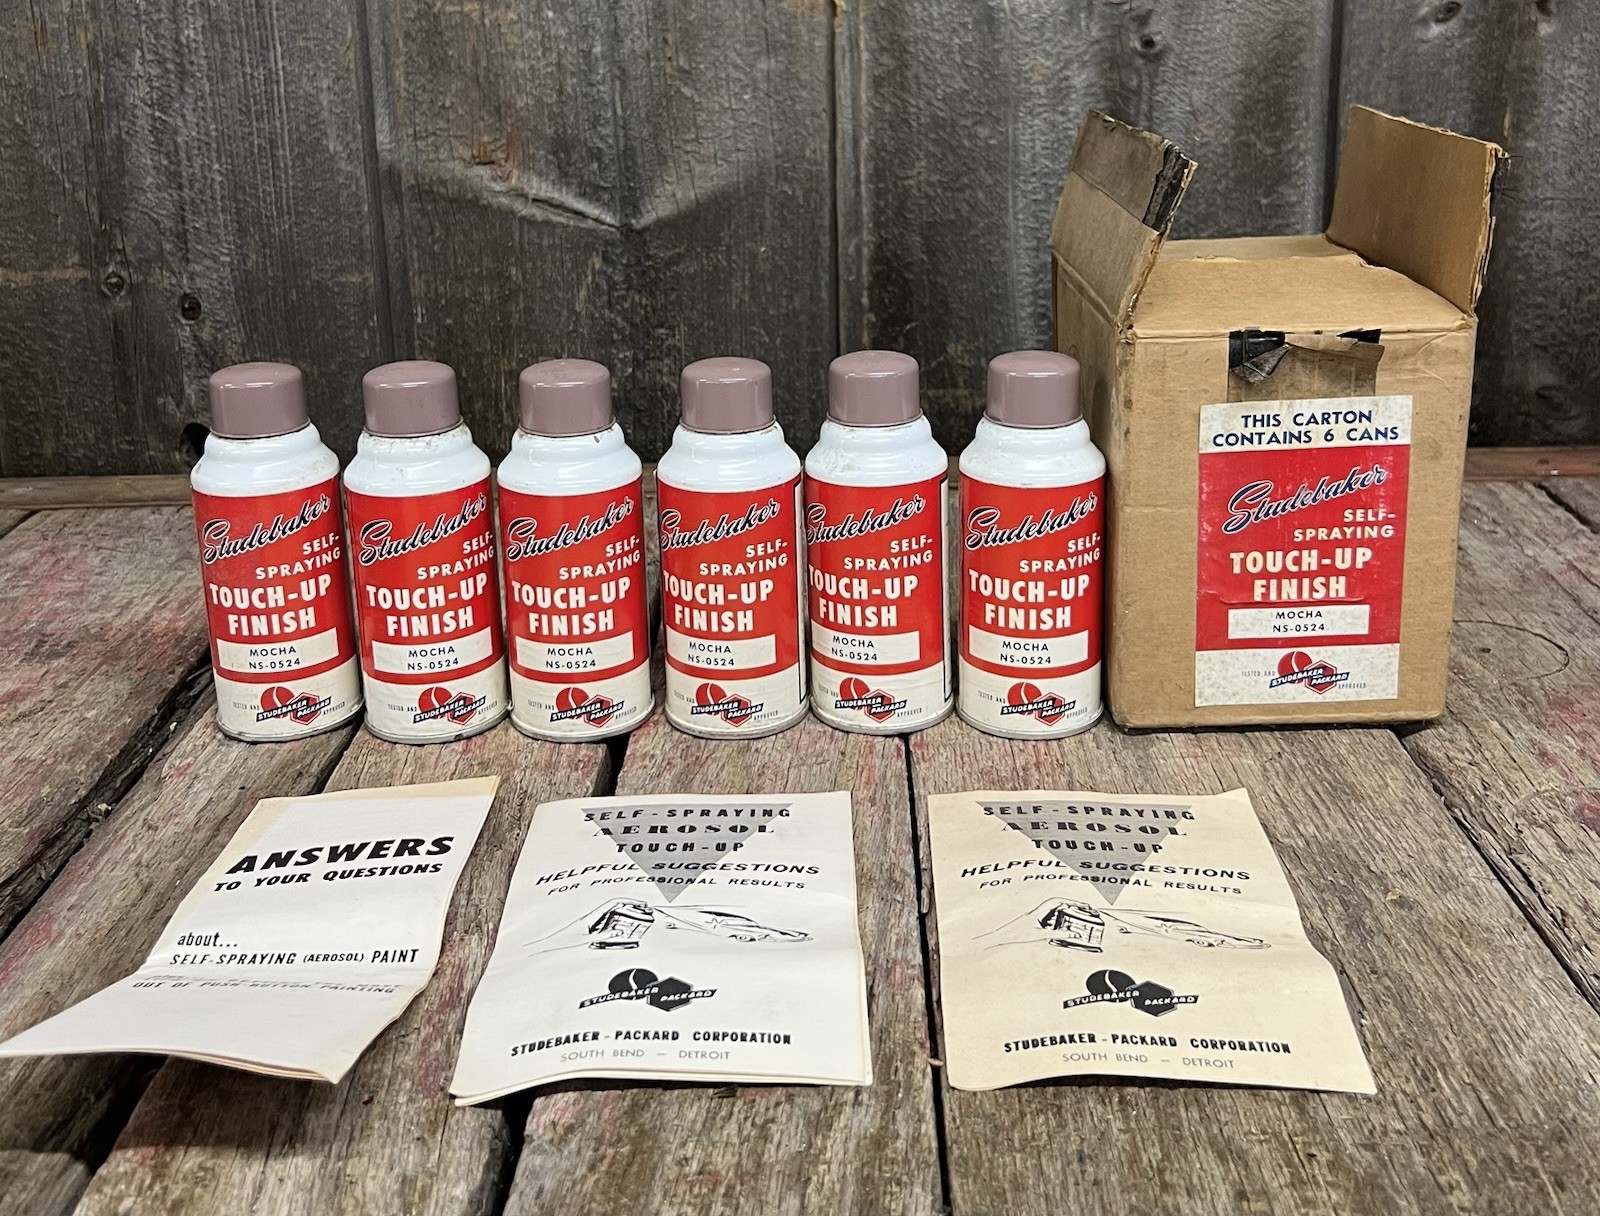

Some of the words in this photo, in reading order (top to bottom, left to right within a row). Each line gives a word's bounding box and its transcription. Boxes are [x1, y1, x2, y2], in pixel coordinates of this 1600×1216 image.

[1241, 414, 1281, 428] THIS
[1293, 410, 1372, 426] CARTON
[1213, 430, 1312, 447] CONTAINS
[1324, 429, 1334, 442] 6
[1346, 427, 1399, 441] CANS
[1222, 464, 1388, 534] Studebaker
[660, 499, 780, 551] Studebaker
[807, 495, 926, 545] Studebaker
[965, 493, 1097, 550] Studebaker
[1343, 509, 1396, 523] SELF-
[203, 494, 330, 564] Studebaker
[359, 493, 486, 565] Studebaker
[507, 497, 634, 560] Studebaker
[1294, 525, 1395, 542] SPRAYING
[303, 535, 339, 555] SELF-
[462, 532, 494, 555] SELF-
[606, 536, 640, 557] SELF-
[746, 539, 787, 558] SELF-
[890, 535, 933, 553] SELF-
[1068, 533, 1100, 553] SELF-
[256, 547, 341, 580] SPRAYING
[417, 546, 494, 580] SPRAYING
[559, 550, 640, 580] SPRAYING
[699, 553, 788, 576] SPRAYING
[844, 550, 933, 571] SPRAYING
[1019, 548, 1100, 573] SPRAYING
[1230, 548, 1373, 573] TOUCH-UP
[210, 574, 332, 610] TOUCH-UP
[366, 573, 488, 610] TOUCH-UP
[663, 570, 774, 605] TOUCH-UP
[809, 565, 918, 599] TOUCH-UP
[969, 570, 1089, 603] TOUCH-UP
[1254, 576, 1346, 601] FINISH
[512, 577, 631, 609] TOUCH-UP
[228, 607, 316, 637] FINISH
[387, 606, 474, 638] FINISH
[529, 609, 614, 636] FINISH
[674, 604, 754, 633] FINISH
[819, 598, 898, 627] FINISH
[985, 603, 1071, 631] FINISH
[1276, 611, 1323, 619] MOCHA
[1272, 623, 1325, 633] NS-0524
[249, 646, 297, 657] MOCHA
[408, 645, 455, 658] MOCHA
[689, 641, 731, 654] MOCHA
[833, 635, 874, 648] MOCHA
[1002, 641, 1049, 652] MOCHA
[547, 647, 593, 657] MOCHA
[688, 654, 735, 666] NS-0524
[832, 648, 877, 661] NS-0524
[1000, 653, 1052, 665] NS-0524
[249, 658, 301, 670] NS-0524
[408, 658, 459, 671] NS-0524
[546, 658, 596, 669] NS-0524
[1271, 669, 1323, 686] STUDEBAKER
[1311, 674, 1347, 685] PACKARD
[594, 825, 774, 837] AEROSOL
[1002, 822, 1187, 836] AEROSOL
[225, 836, 454, 875] ANSWERS
[616, 842, 745, 853] TOUCH-UP
[1032, 840, 1163, 853] TOUCH-UP
[214, 881, 241, 892] TO
[254, 872, 311, 887] YOUR
[322, 863, 442, 881] QUESTIONS
[535, 864, 639, 886] HELPFUL
[652, 863, 821, 875] SUGGESTIONS
[961, 860, 1067, 877] HELPFUL
[1080, 861, 1250, 880] SUGGESTIONS
[548, 883, 580, 896] FOR
[590, 876, 717, 886] PROFESSIONAL
[728, 878, 805, 889] RESULTS
[980, 878, 1012, 889] FOR
[1023, 874, 1152, 886] PROFESSIONAL
[1164, 882, 1242, 894] RESULTS
[178, 933, 238, 947] about...
[170, 953, 296, 965] SELF-SPRAYING
[303, 953, 364, 963] (AEROSOL)
[371, 949, 419, 963] PAINT
[320, 985, 395, 994] PAINTING
[584, 987, 659, 1007] STUDEBAKER
[660, 990, 712, 1001] PACKARD
[1066, 990, 1140, 1006] STUDEBAKER
[1145, 995, 1195, 1005] PACKARD
[693, 1031, 791, 1045] CORPORATION
[1190, 1038, 1290, 1054] CORPORATION
[561, 1050, 604, 1062] SOUTH
[679, 1051, 730, 1060] DETROIT
[1063, 1053, 1107, 1062] SOUTH
[1116, 1054, 1148, 1063] BEND
[1183, 1057, 1234, 1069] DETROIT
